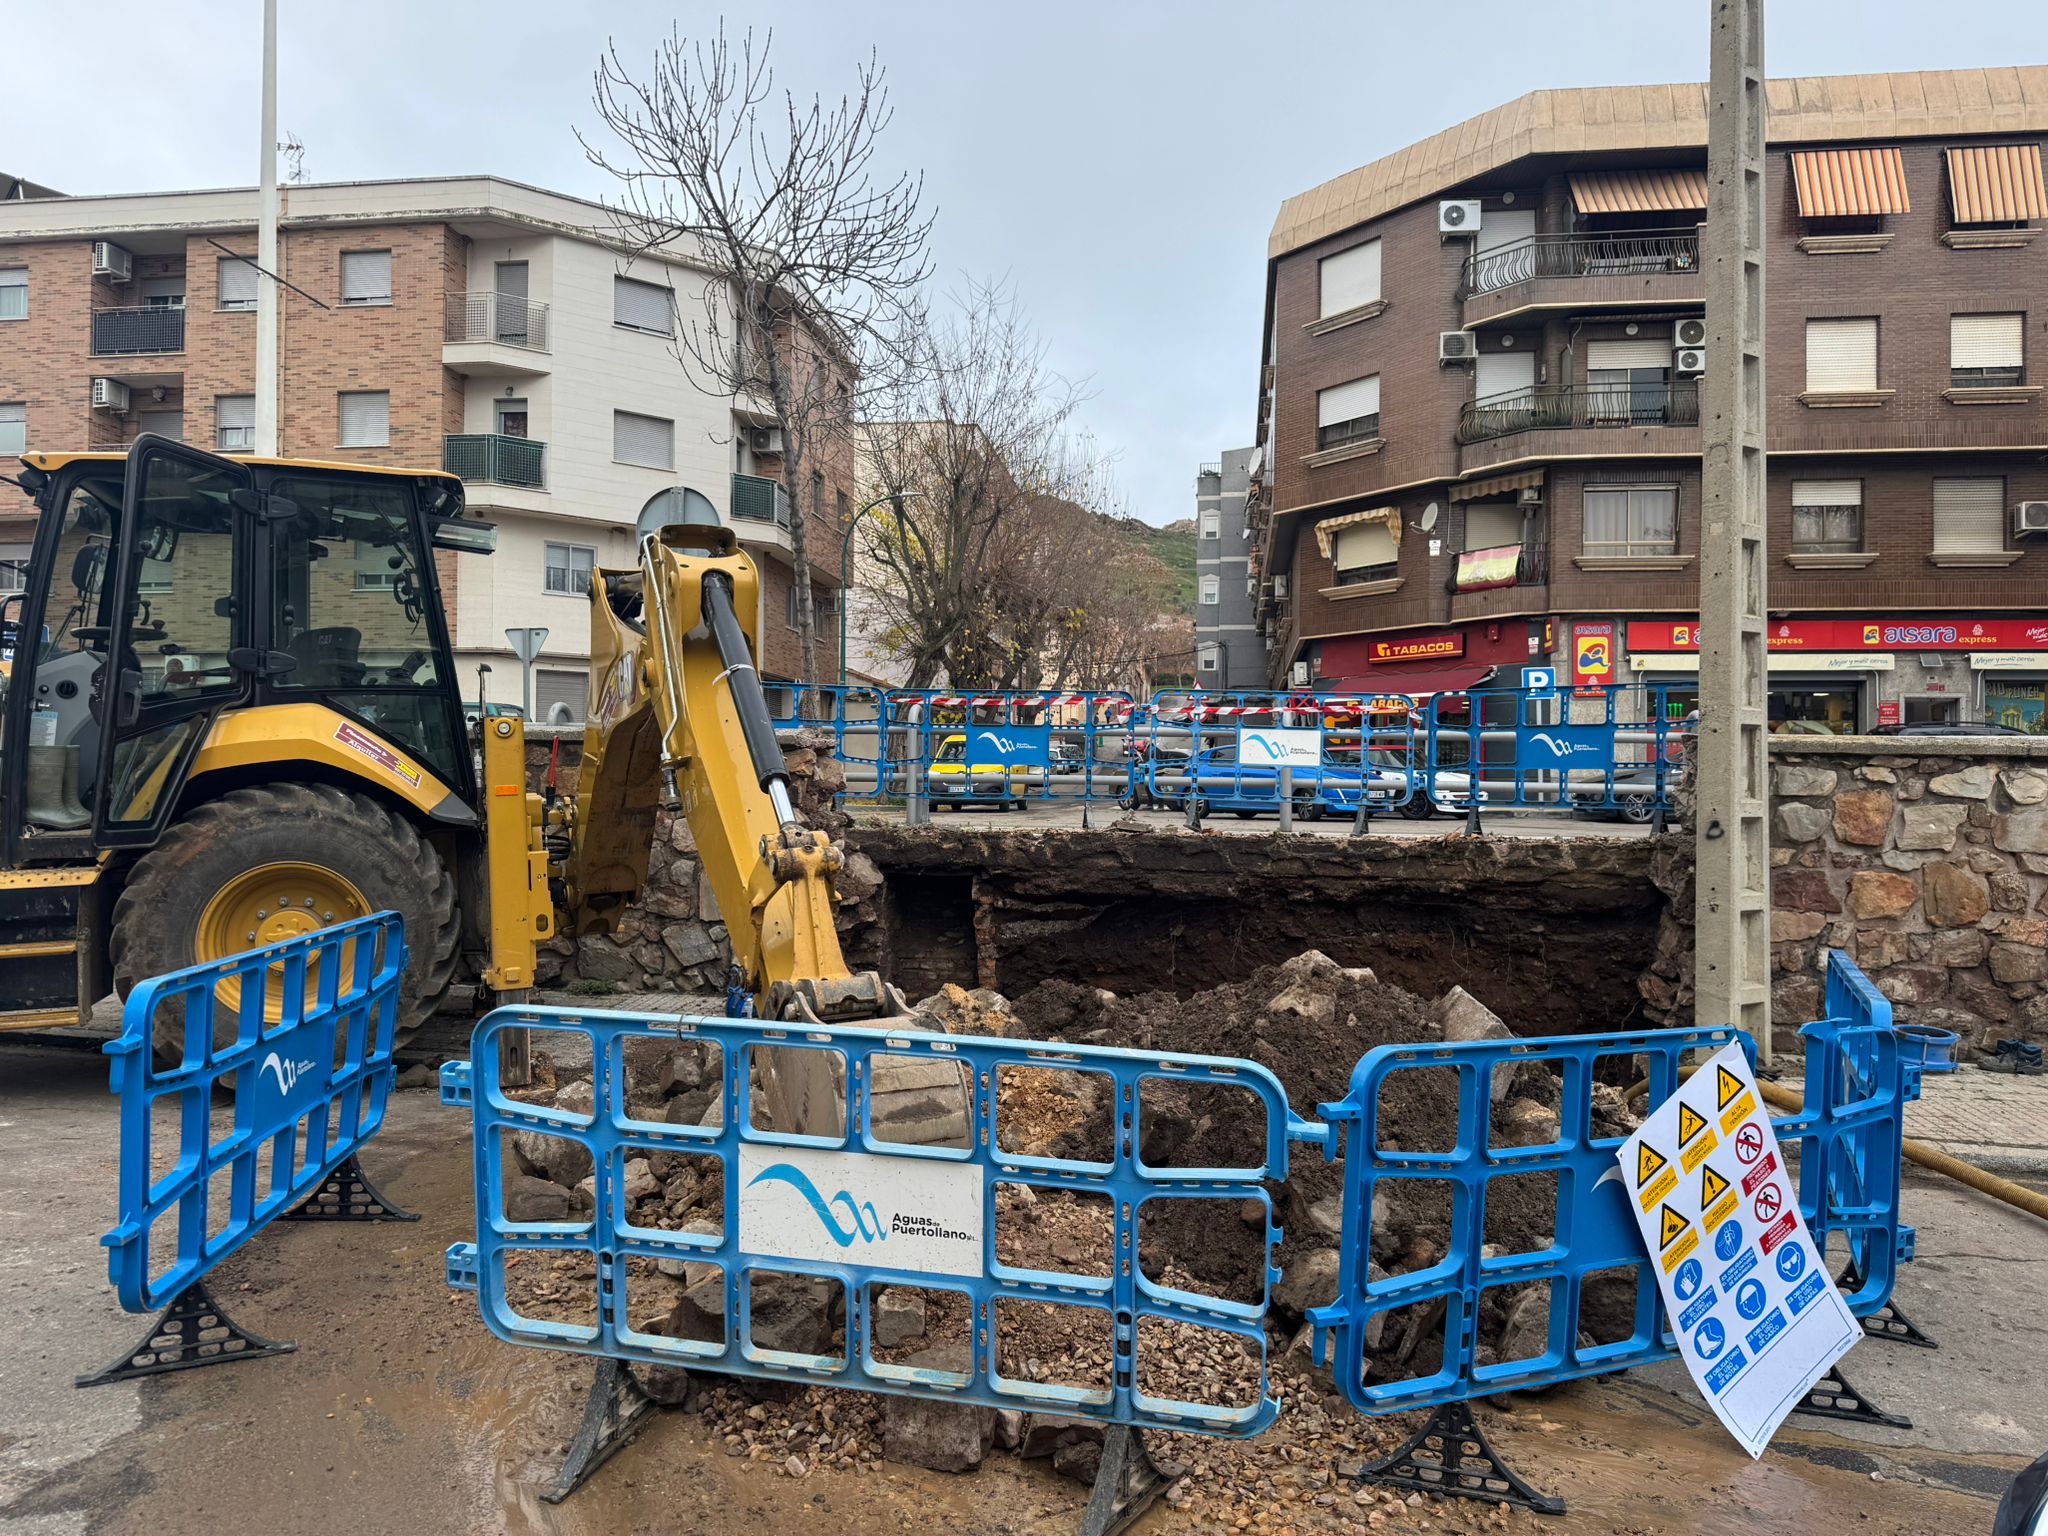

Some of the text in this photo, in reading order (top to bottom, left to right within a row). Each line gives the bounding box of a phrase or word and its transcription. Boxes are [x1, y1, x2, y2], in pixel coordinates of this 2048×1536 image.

[1575, 625, 1611, 635] alsara
[1884, 627, 1957, 643] alsara
[1393, 642, 1454, 655] TABACOS
[1959, 636, 1997, 645] express
[1529, 672, 1549, 695] P
[348, 740, 379, 760] Alquiler
[1728, 1105, 1748, 1127] TENSIÓN
[1730, 1103, 1741, 1116] ALTA
[892, 1212, 933, 1227] Aguas
[892, 1223, 967, 1240] Puertollano
[1787, 1271, 1819, 1304] ES OBLIGATORIO
[1797, 1284, 1813, 1301] EL USO
[1798, 1286, 1818, 1308] DE GAFAS
[1679, 1286, 1713, 1321] ES OBLIGATORIO
[1686, 1300, 1712, 1326] DE GUANTES
[1689, 1300, 1705, 1317] EL USO
[1747, 1308, 1780, 1342] ES OBLIGATORIO
[1758, 1322, 1773, 1339] EL USO
[1758, 1324, 1780, 1346] DE CASCO
[1706, 1346, 1740, 1381] ES OBLIGATORIO
[1717, 1361, 1733, 1379] EL USO
[1718, 1363, 1739, 1386] DE BOTAS
